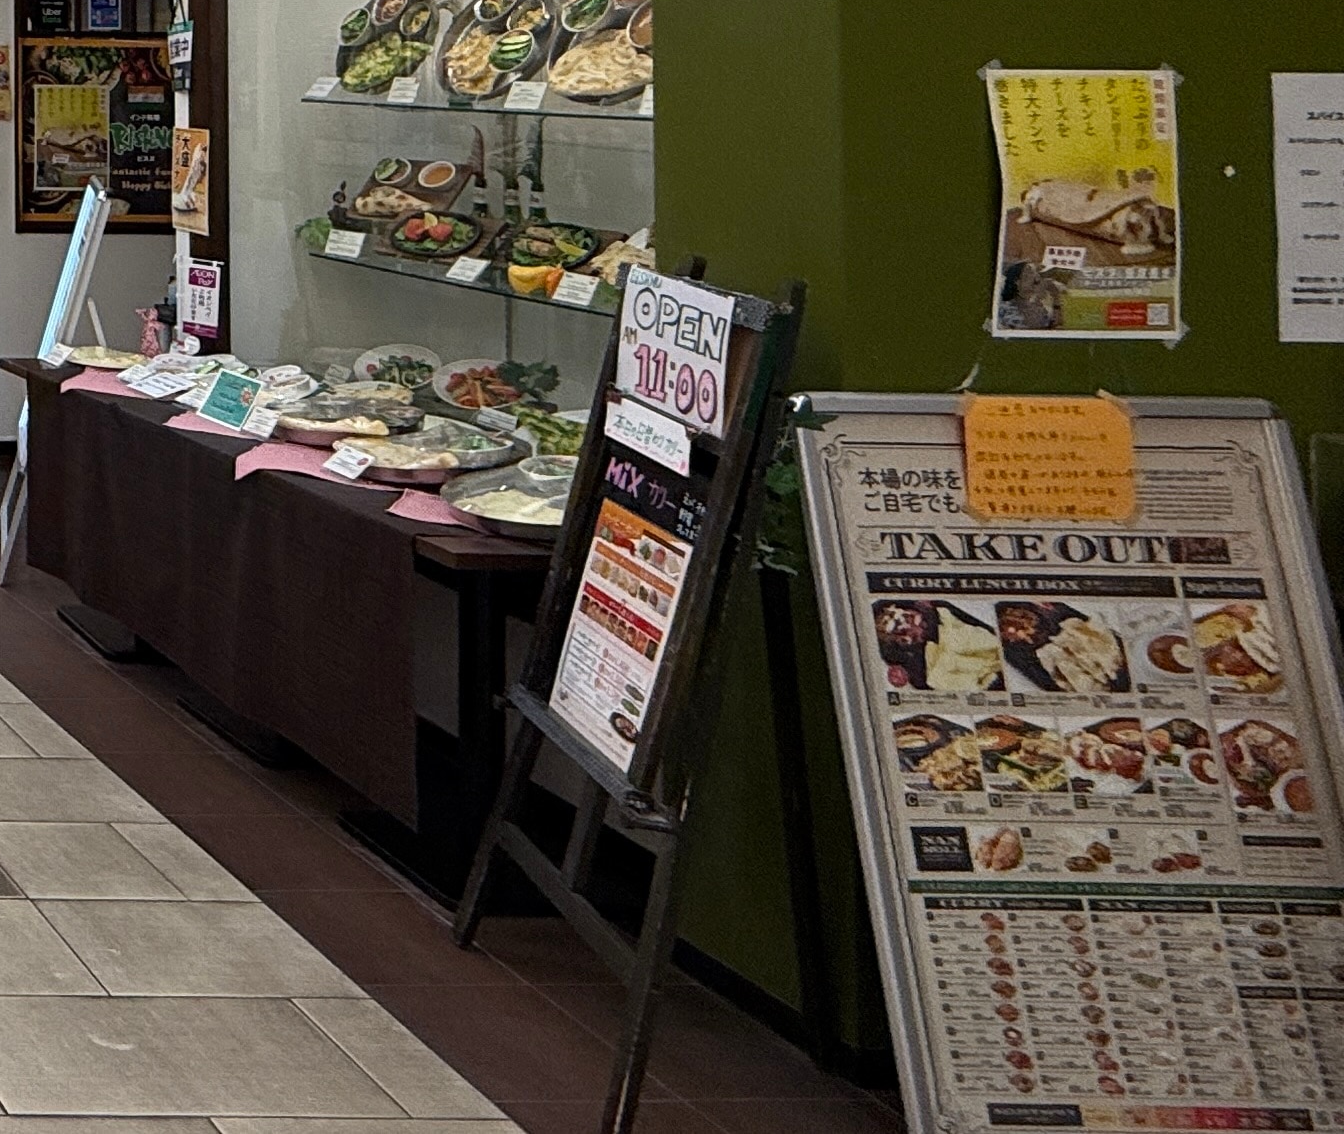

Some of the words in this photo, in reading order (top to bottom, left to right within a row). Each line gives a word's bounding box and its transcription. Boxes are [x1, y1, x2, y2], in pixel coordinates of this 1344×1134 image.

[42, 8, 62, 17] Uber
[1020, 78, 1047, 153] 特大ナンで
[1050, 77, 1070, 138] チーズを
[1077, 77, 1096, 137] チキンと
[622, 326, 638, 345] AM
[634, 286, 728, 364] OPEN
[634, 343, 718, 424] 11:00
[858, 468, 962, 489] 本場の味を
[881, 532, 1047, 561] TAKE
[1053, 533, 1169, 564] OUT
[883, 576, 956, 590] CURRY
[962, 576, 1030, 590] LUNCH
[1034, 578, 1082, 590] BOX
